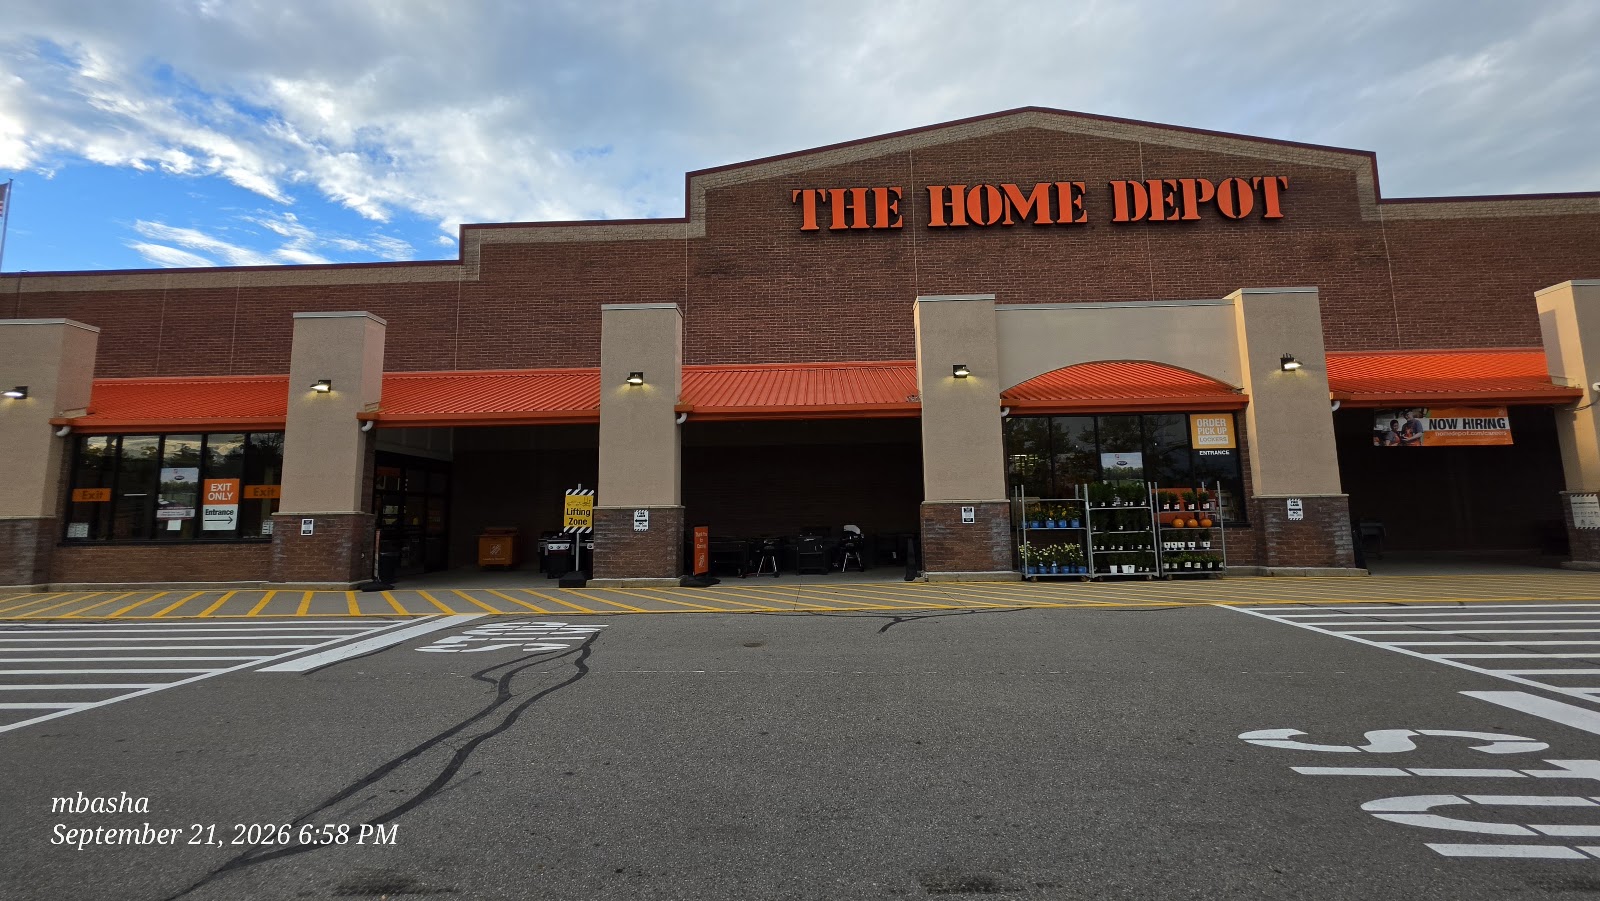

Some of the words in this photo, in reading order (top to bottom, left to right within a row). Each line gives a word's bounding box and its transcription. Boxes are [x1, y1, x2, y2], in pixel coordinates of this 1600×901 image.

[791, 187, 904, 231] THE
[924, 180, 1089, 228] HOME
[1109, 175, 1289, 223] DEPOT
[1196, 418, 1226, 427] ORDER
[1428, 418, 1458, 430] NOW
[1462, 417, 1506, 430] HIRING
[1197, 427, 1215, 435] PICK
[1216, 427, 1228, 435] UP
[210, 483, 232, 492] EXIT
[252, 487, 276, 497] Exit
[81, 490, 104, 500] Exit
[207, 492, 233, 501] ONLY
[204, 508, 234, 516] Entrance
[566, 507, 591, 517] Lifting
[568, 517, 588, 526] Zone
